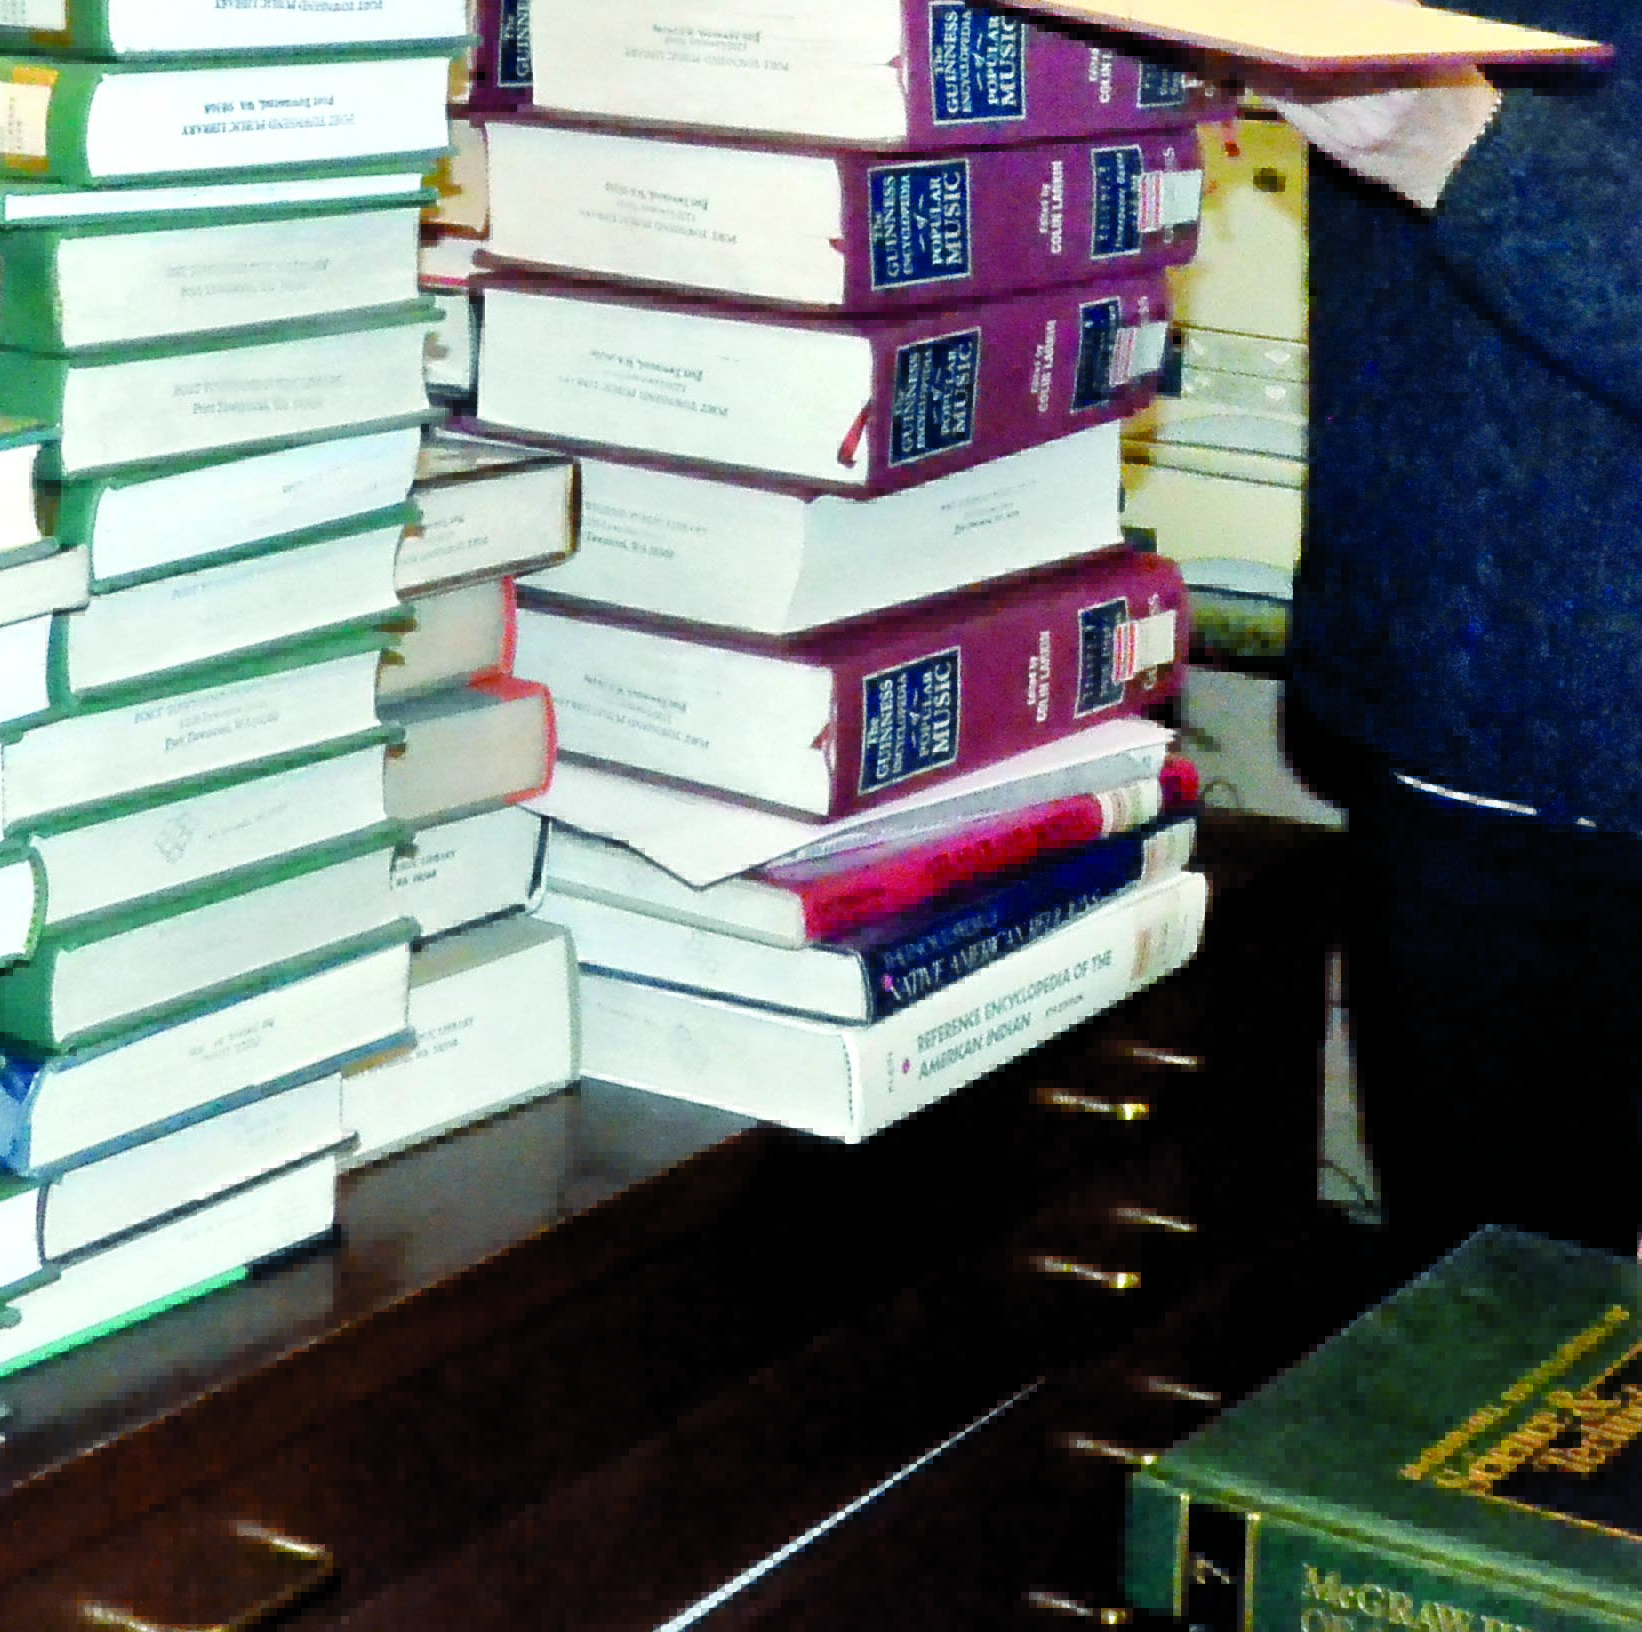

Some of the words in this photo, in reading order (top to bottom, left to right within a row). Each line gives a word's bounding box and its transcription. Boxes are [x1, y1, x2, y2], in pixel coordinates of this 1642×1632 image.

[944, 9, 958, 114] GUINNESS
[959, 9, 973, 113] ENCYCLOPEDIA
[986, 15, 1000, 105] POPULAR
[1001, 18, 1018, 106] MUSIC
[883, 175, 899, 278] GUINNESS
[930, 175, 944, 265] POPULAR
[944, 171, 963, 265] MUSIC
[900, 351, 919, 453] GUINNESS
[952, 340, 974, 433] MUSIC
[875, 678, 894, 779] GUINNESS
[919, 670, 934, 758] POPULAR
[931, 660, 953, 753] MUSIC
[917, 1007, 981, 1054] REFERENCE
[984, 968, 1071, 1021] ENCYCLOPEDIA
[1073, 962, 1088, 981] OF
[1092, 949, 1113, 970] THE
[918, 1035, 983, 1081] AMERICAN
[986, 1011, 1032, 1049] INDIAN
